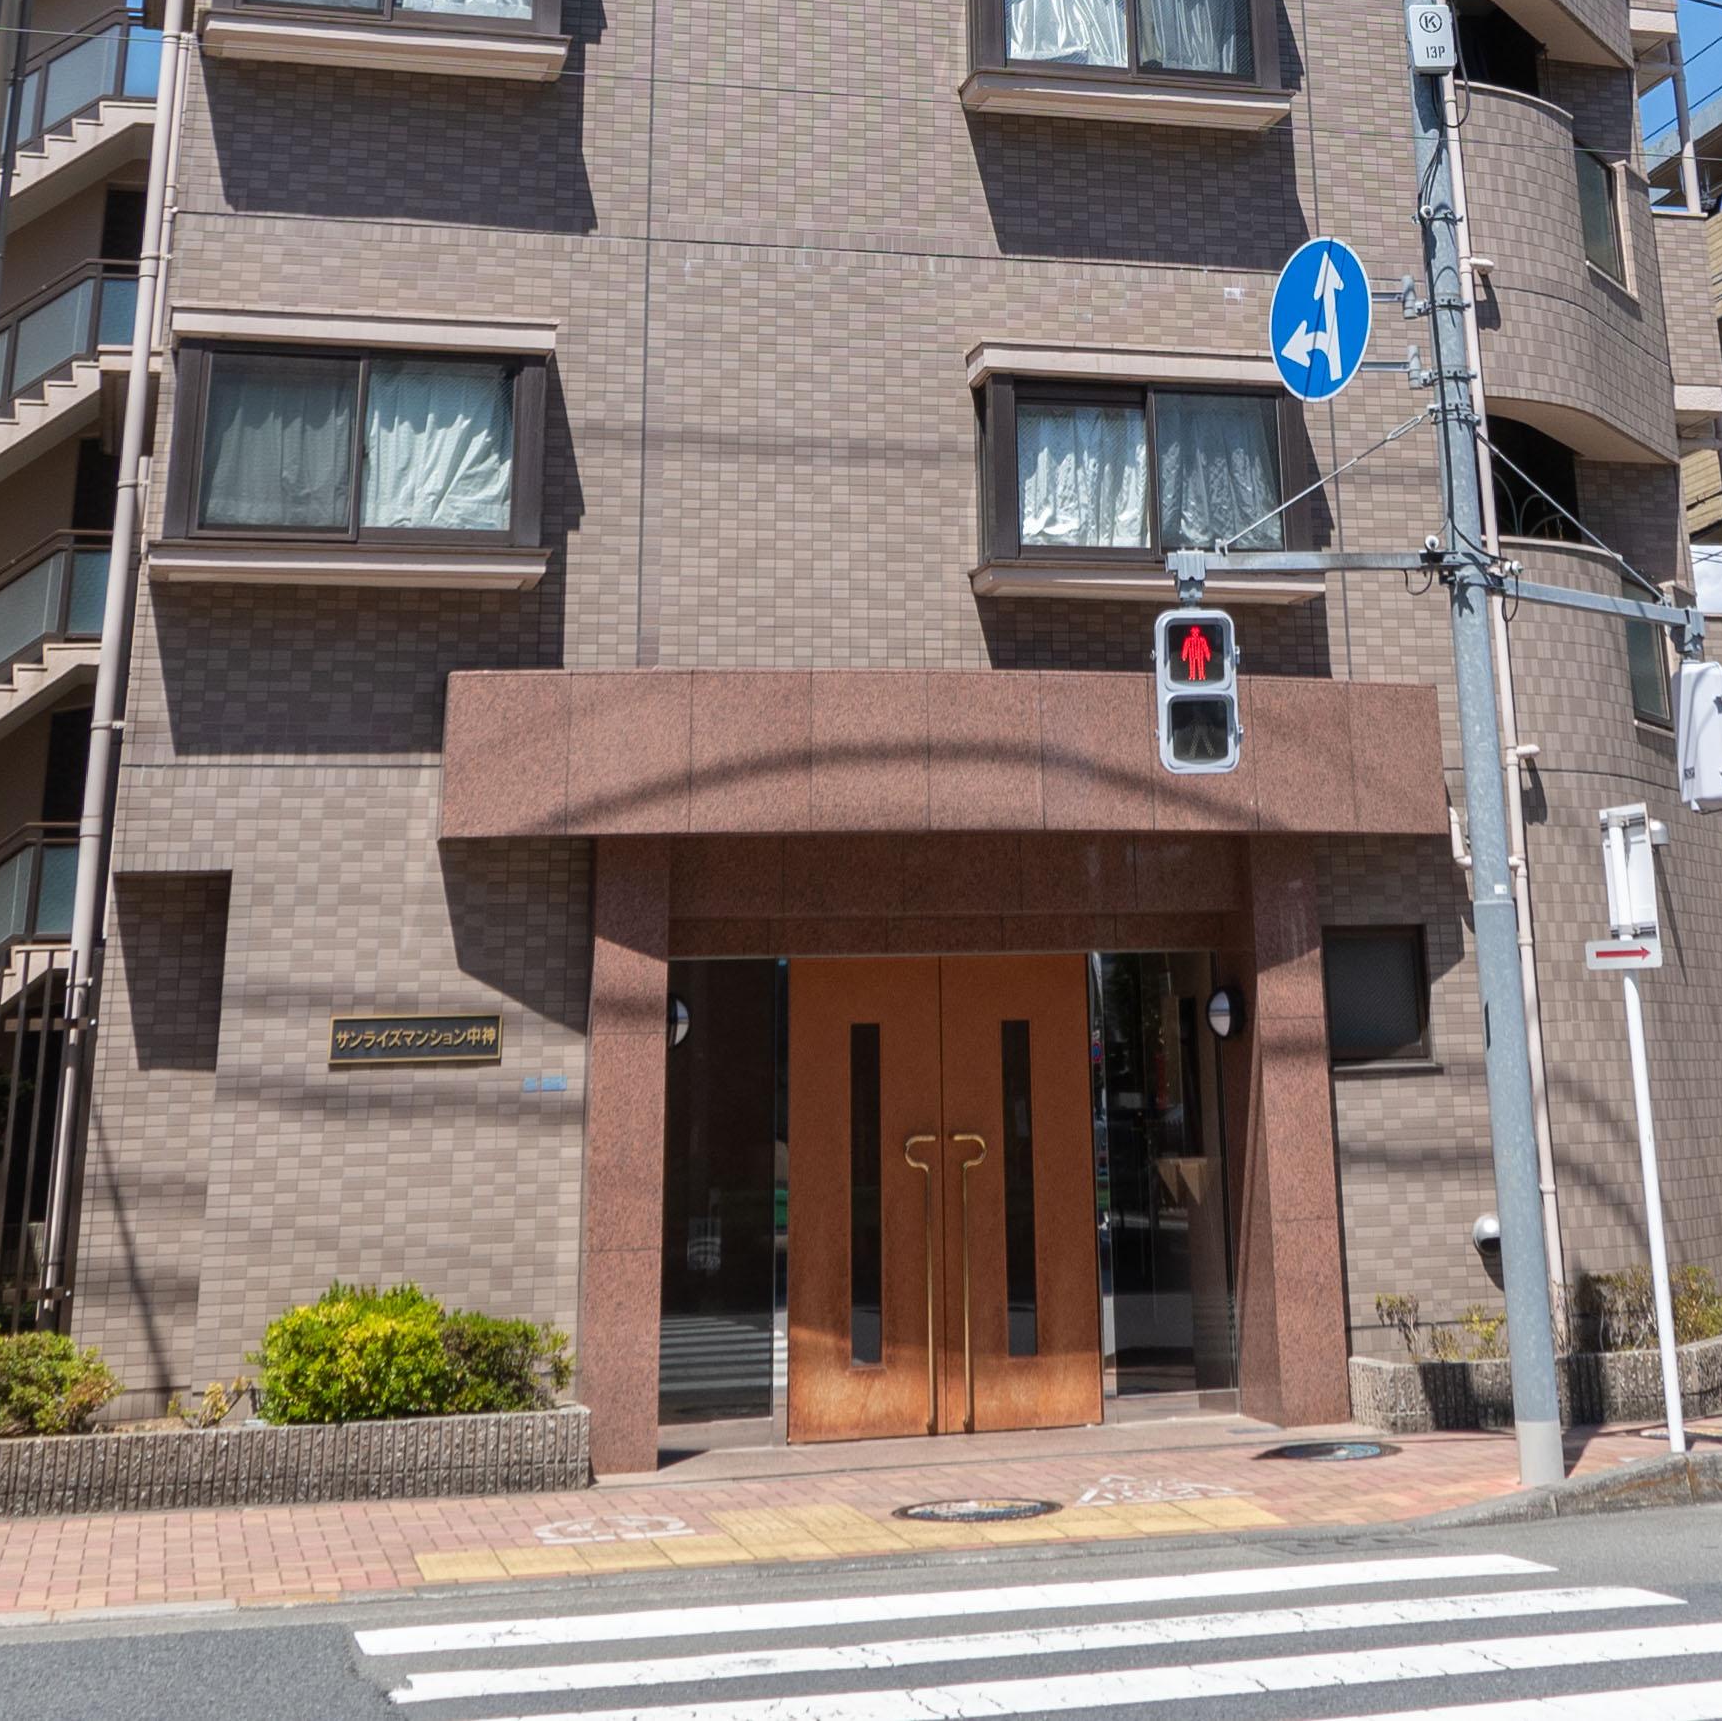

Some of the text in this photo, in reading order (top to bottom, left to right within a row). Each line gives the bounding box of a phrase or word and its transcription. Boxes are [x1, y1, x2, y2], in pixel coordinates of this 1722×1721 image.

[1425, 45, 1446, 59] 13P
[335, 1025, 496, 1051] サンライズマンション中神
